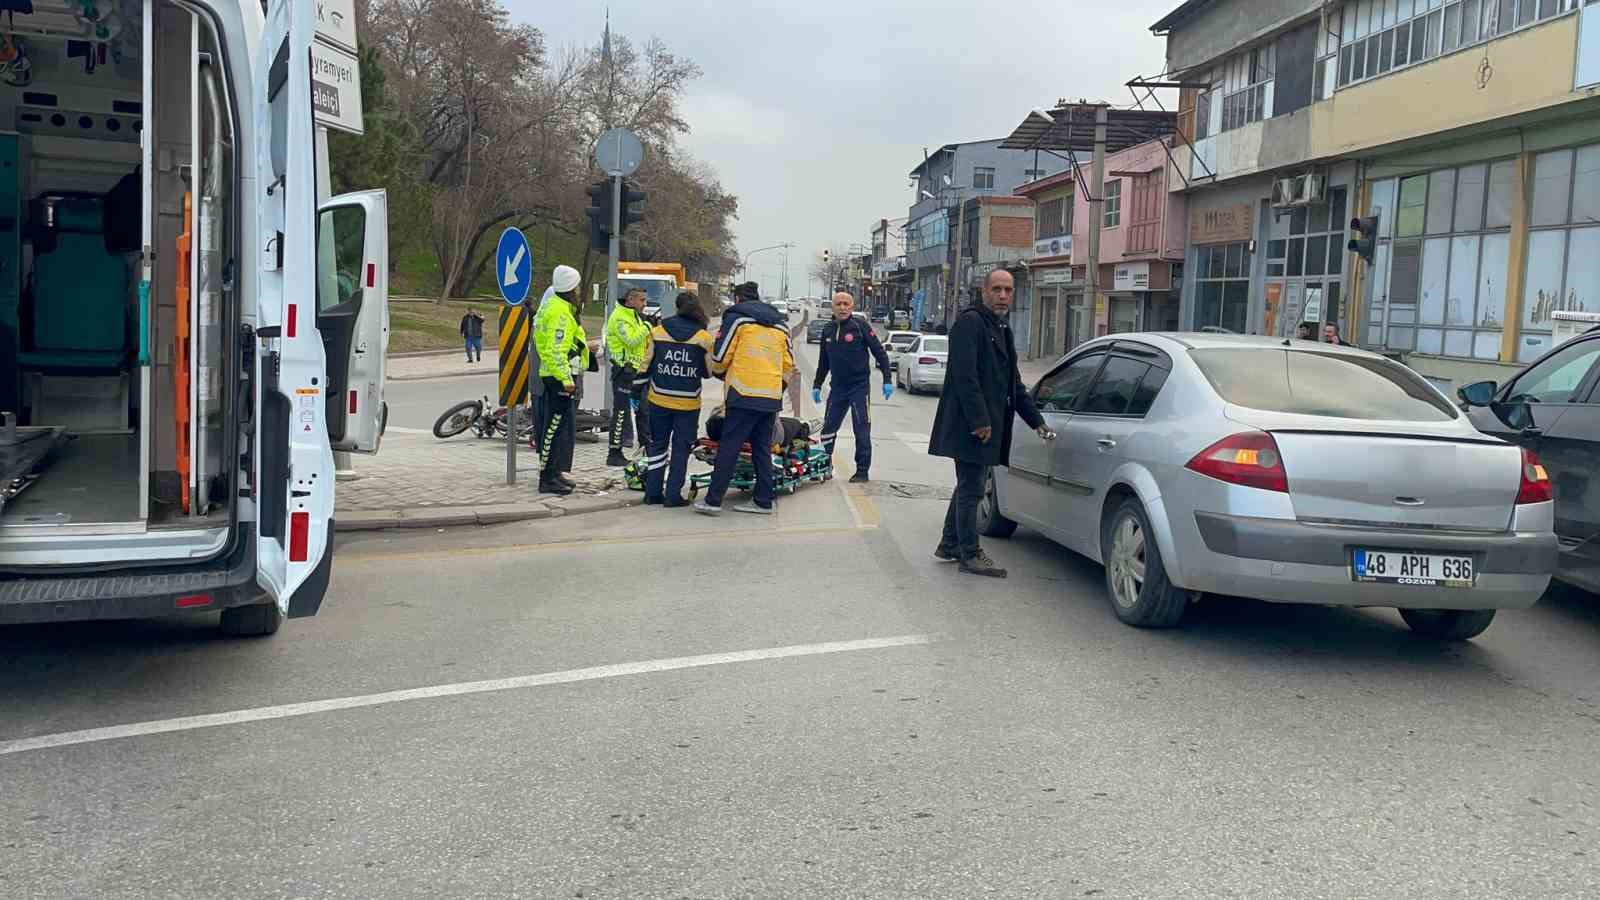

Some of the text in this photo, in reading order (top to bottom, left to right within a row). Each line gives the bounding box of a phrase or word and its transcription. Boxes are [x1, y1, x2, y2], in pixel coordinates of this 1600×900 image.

[313, 56, 353, 82] yramyeri
[314, 90, 338, 113] aleiçi
[664, 349, 692, 362] ACİL
[657, 363, 697, 378] SAĞLIK
[1366, 553, 1471, 579] 48 APH 636
